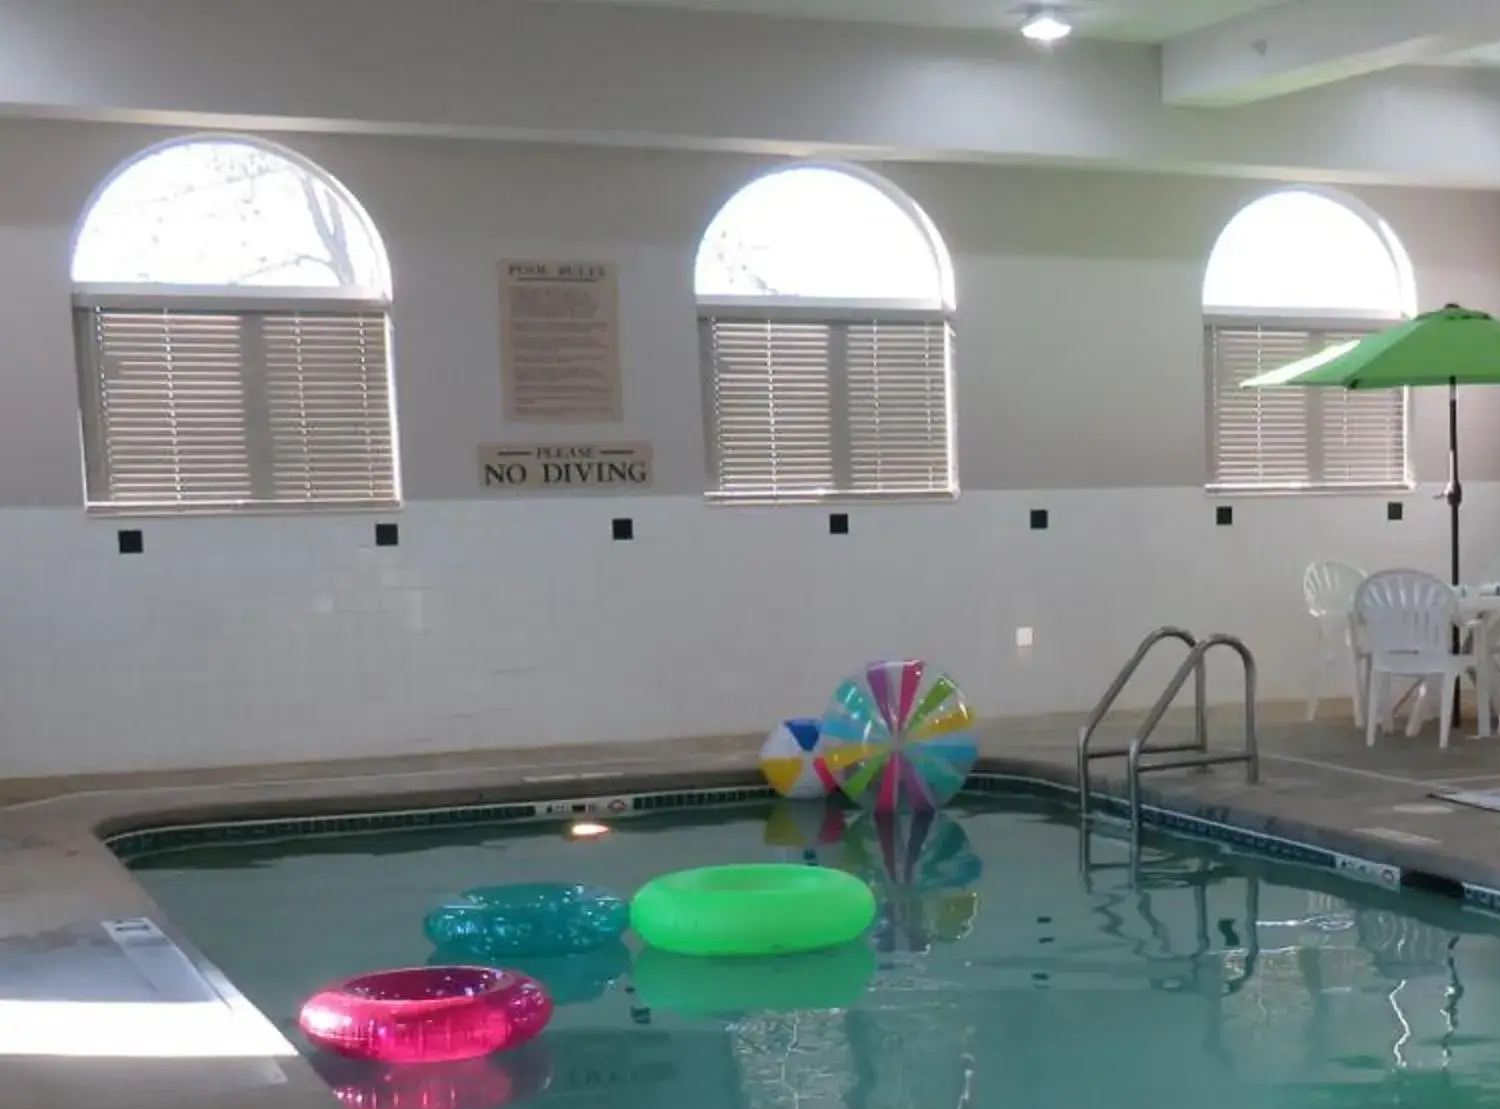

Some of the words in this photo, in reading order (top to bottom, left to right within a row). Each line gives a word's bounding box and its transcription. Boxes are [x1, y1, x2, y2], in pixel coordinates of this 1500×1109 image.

[536, 446, 594, 459] PLEASE
[484, 463, 527, 485] NO
[543, 462, 647, 484] DIVING
